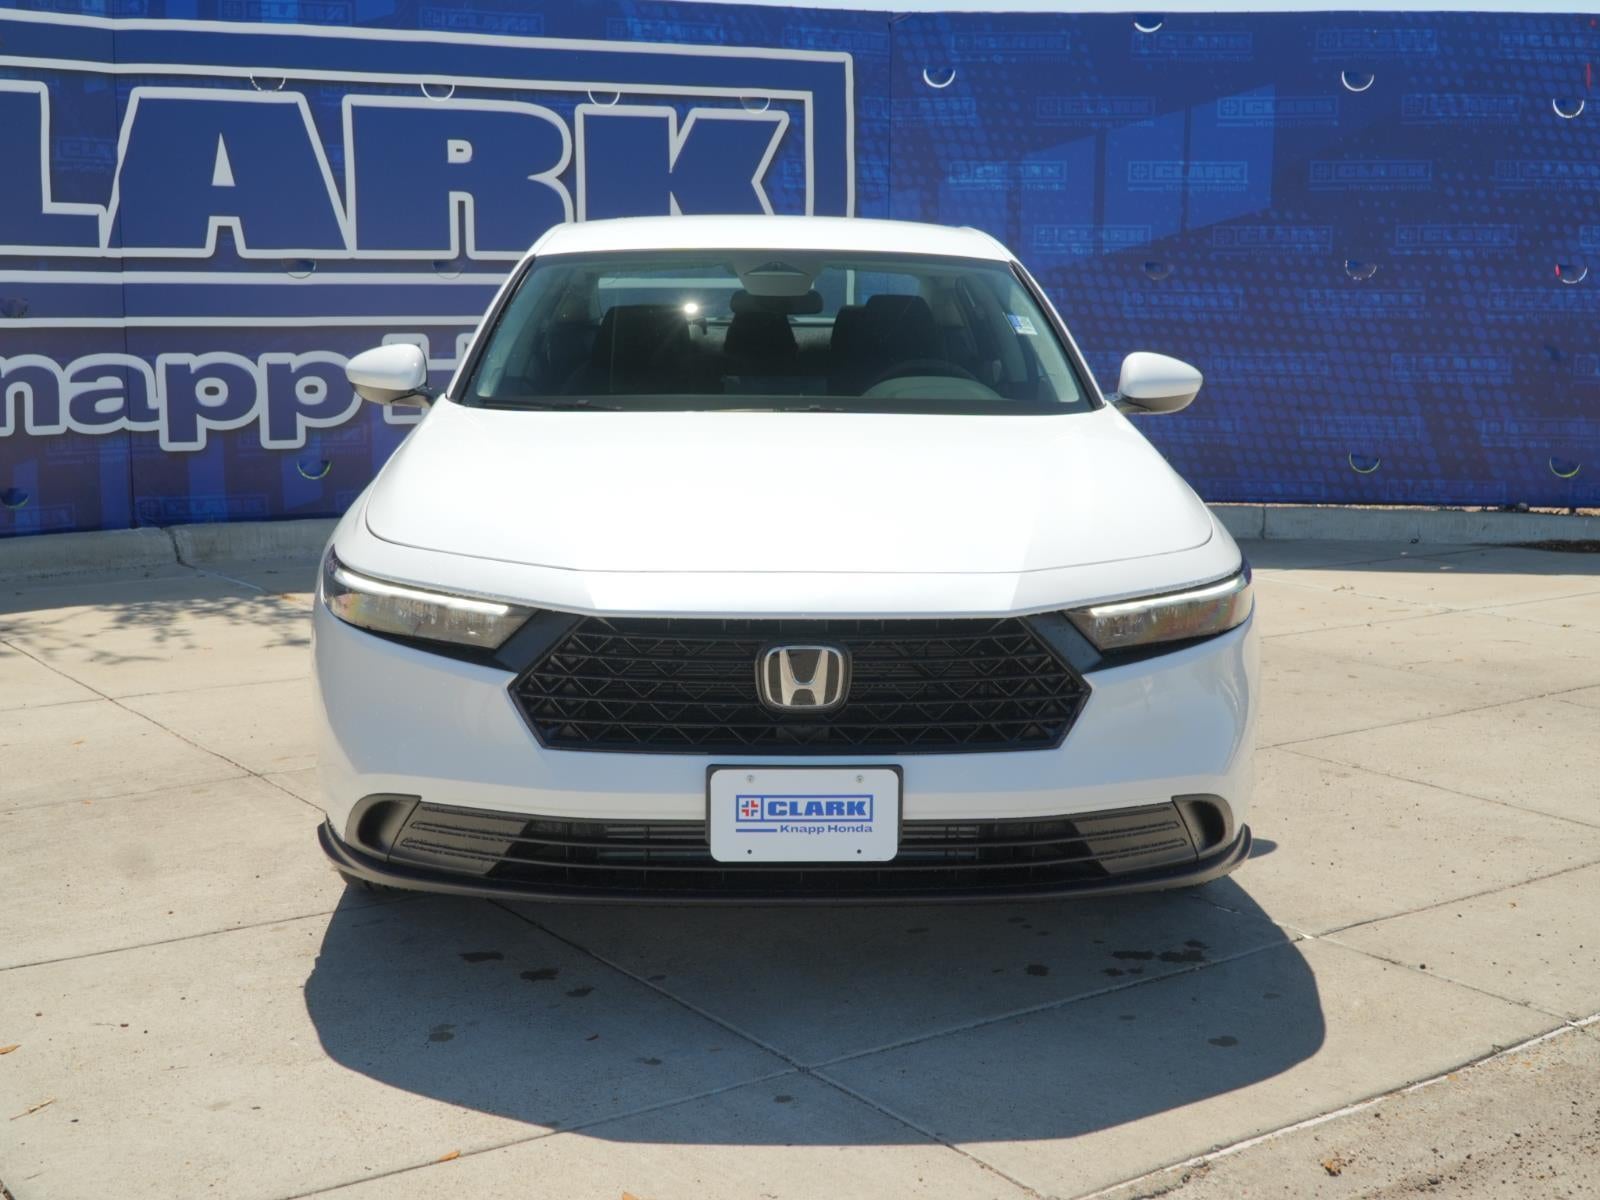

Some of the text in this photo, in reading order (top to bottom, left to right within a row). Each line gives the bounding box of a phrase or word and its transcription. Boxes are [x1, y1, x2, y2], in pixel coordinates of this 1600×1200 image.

[767, 801, 867, 817] CLARK
[780, 824, 873, 835] Knapp Honda
